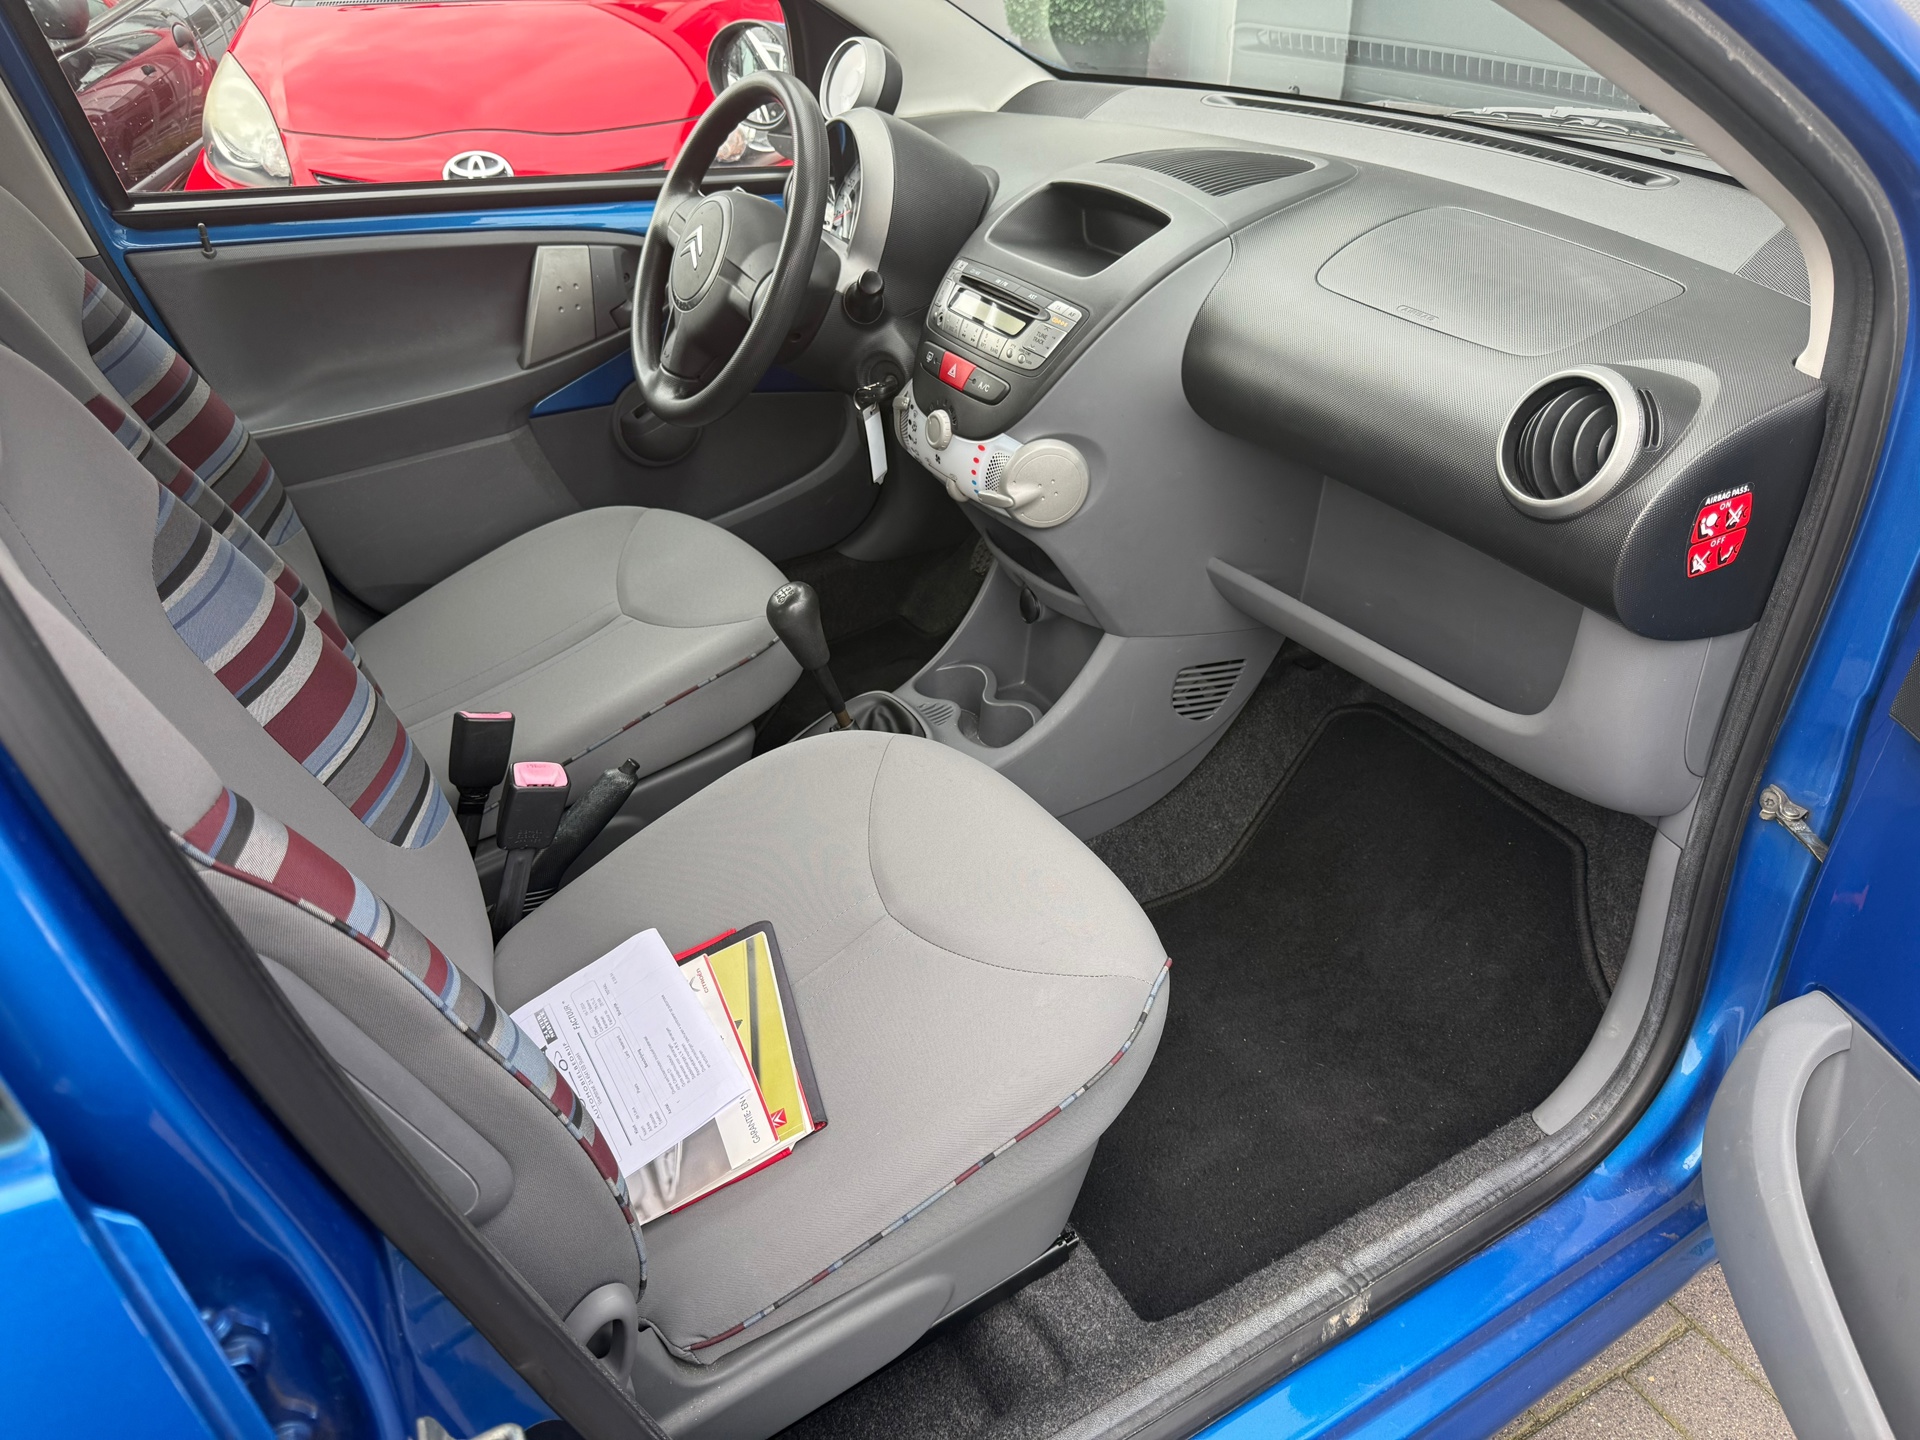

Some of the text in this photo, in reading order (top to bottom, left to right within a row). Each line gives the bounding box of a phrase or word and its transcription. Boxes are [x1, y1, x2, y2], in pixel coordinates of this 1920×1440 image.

[977, 381, 991, 393] A/C
[1705, 485, 1750, 506] AIRBAG PASS.
[1720, 501, 1732, 510] ON
[1710, 536, 1726, 548] OFF
[540, 1010, 555, 1039] SERVICE
[563, 1004, 580, 1030] FACTUUR
[562, 1041, 601, 1119] AUTOMOBIELBEDRIJF
[738, 1098, 749, 1111] EN
